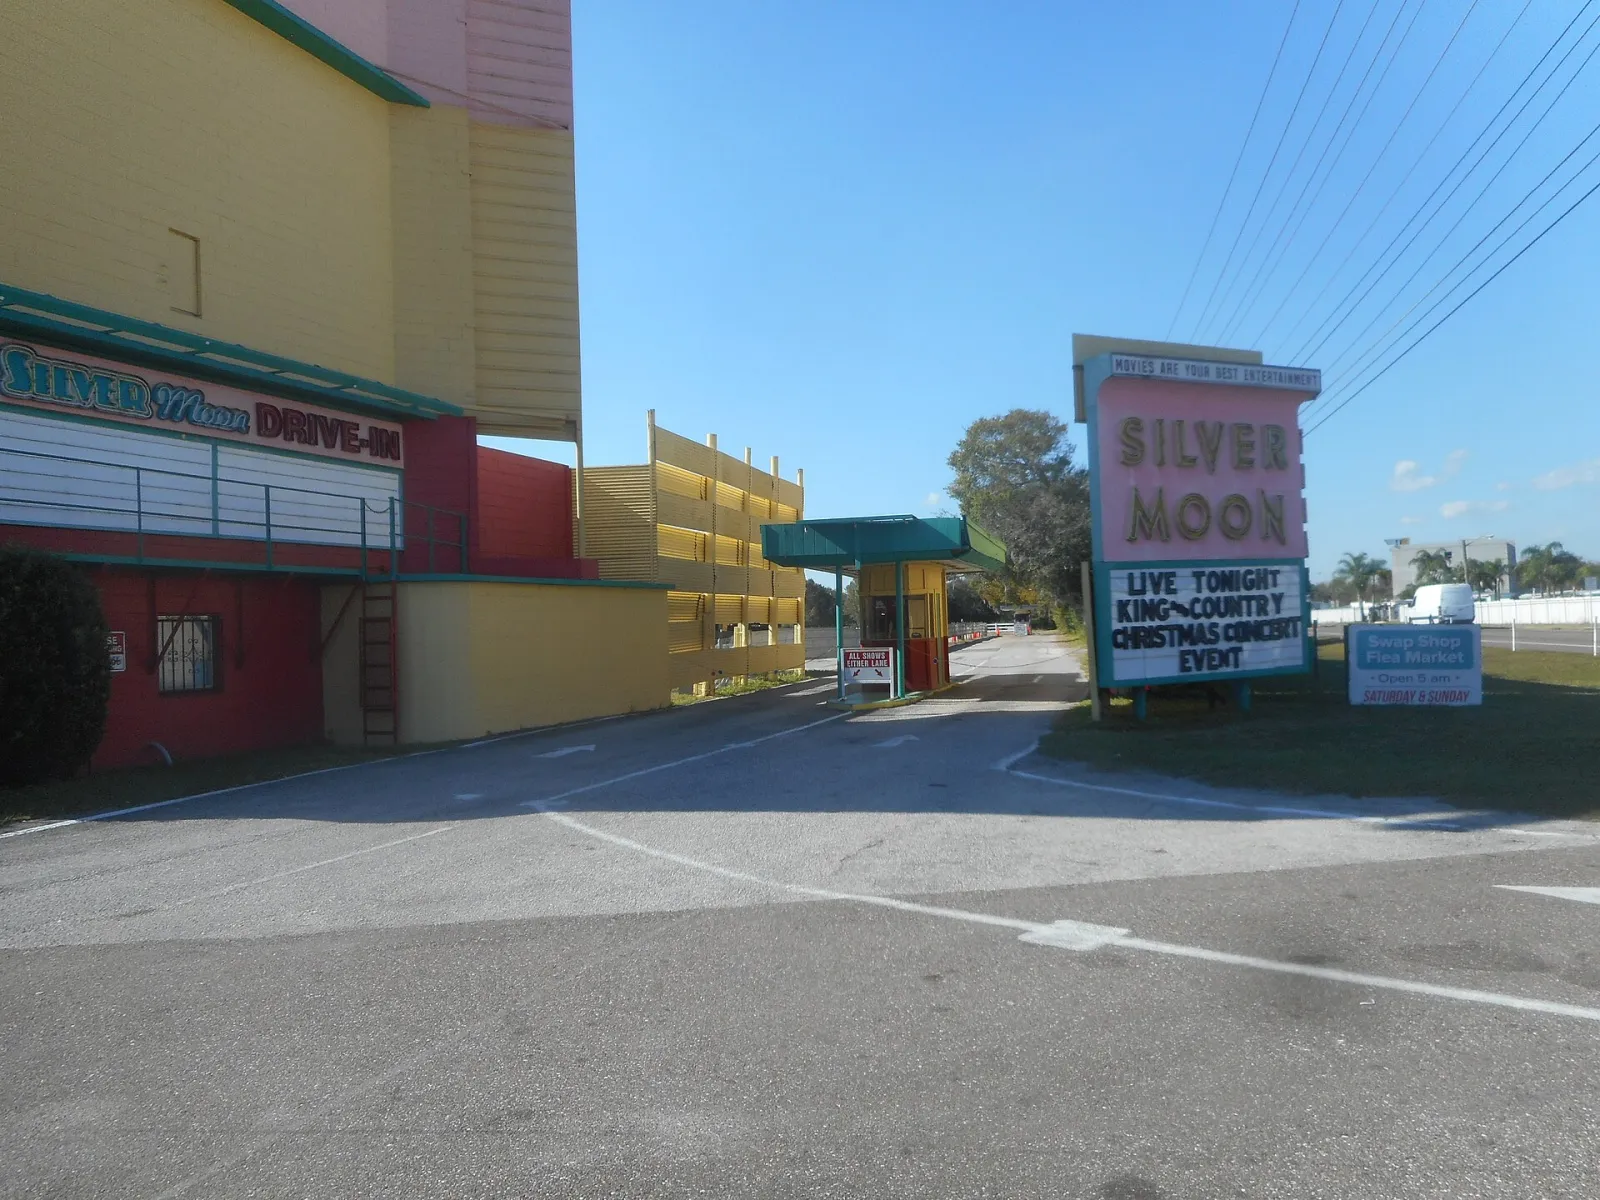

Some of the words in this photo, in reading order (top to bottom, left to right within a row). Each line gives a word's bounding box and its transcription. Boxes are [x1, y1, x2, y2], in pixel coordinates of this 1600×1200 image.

[1115, 358, 1155, 374] MOVIES
[1160, 361, 1179, 376] ARE
[1185, 363, 1210, 378] YOUR
[1215, 366, 1238, 381] BEST
[1244, 368, 1318, 388] ENTERTAINMENT
[2, 345, 152, 419] SILVER
[154, 383, 250, 434] Moon
[255, 402, 400, 461] DRIVE-IN
[1119, 416, 1289, 476] SILVER
[1125, 486, 1287, 546] MOON
[1127, 571, 1178, 596] LIVE
[1192, 568, 1281, 594] TONIGHT
[1117, 598, 1170, 623] KING
[1189, 592, 1284, 620] COUNTRY
[1112, 621, 1220, 650] CHRISTMAS
[1223, 615, 1302, 643] CONCERT
[1369, 635, 1414, 650] Swap
[1417, 635, 1461, 650] Shop
[1179, 646, 1243, 673] EVENT
[1367, 651, 1400, 664] Flea
[1406, 651, 1465, 664] Market
[1378, 673, 1414, 685] Open
[1430, 675, 1451, 683] am
[1363, 690, 1416, 703] SATURDAY
[1418, 690, 1426, 701] &
[1427, 690, 1470, 703] SUNDAY
